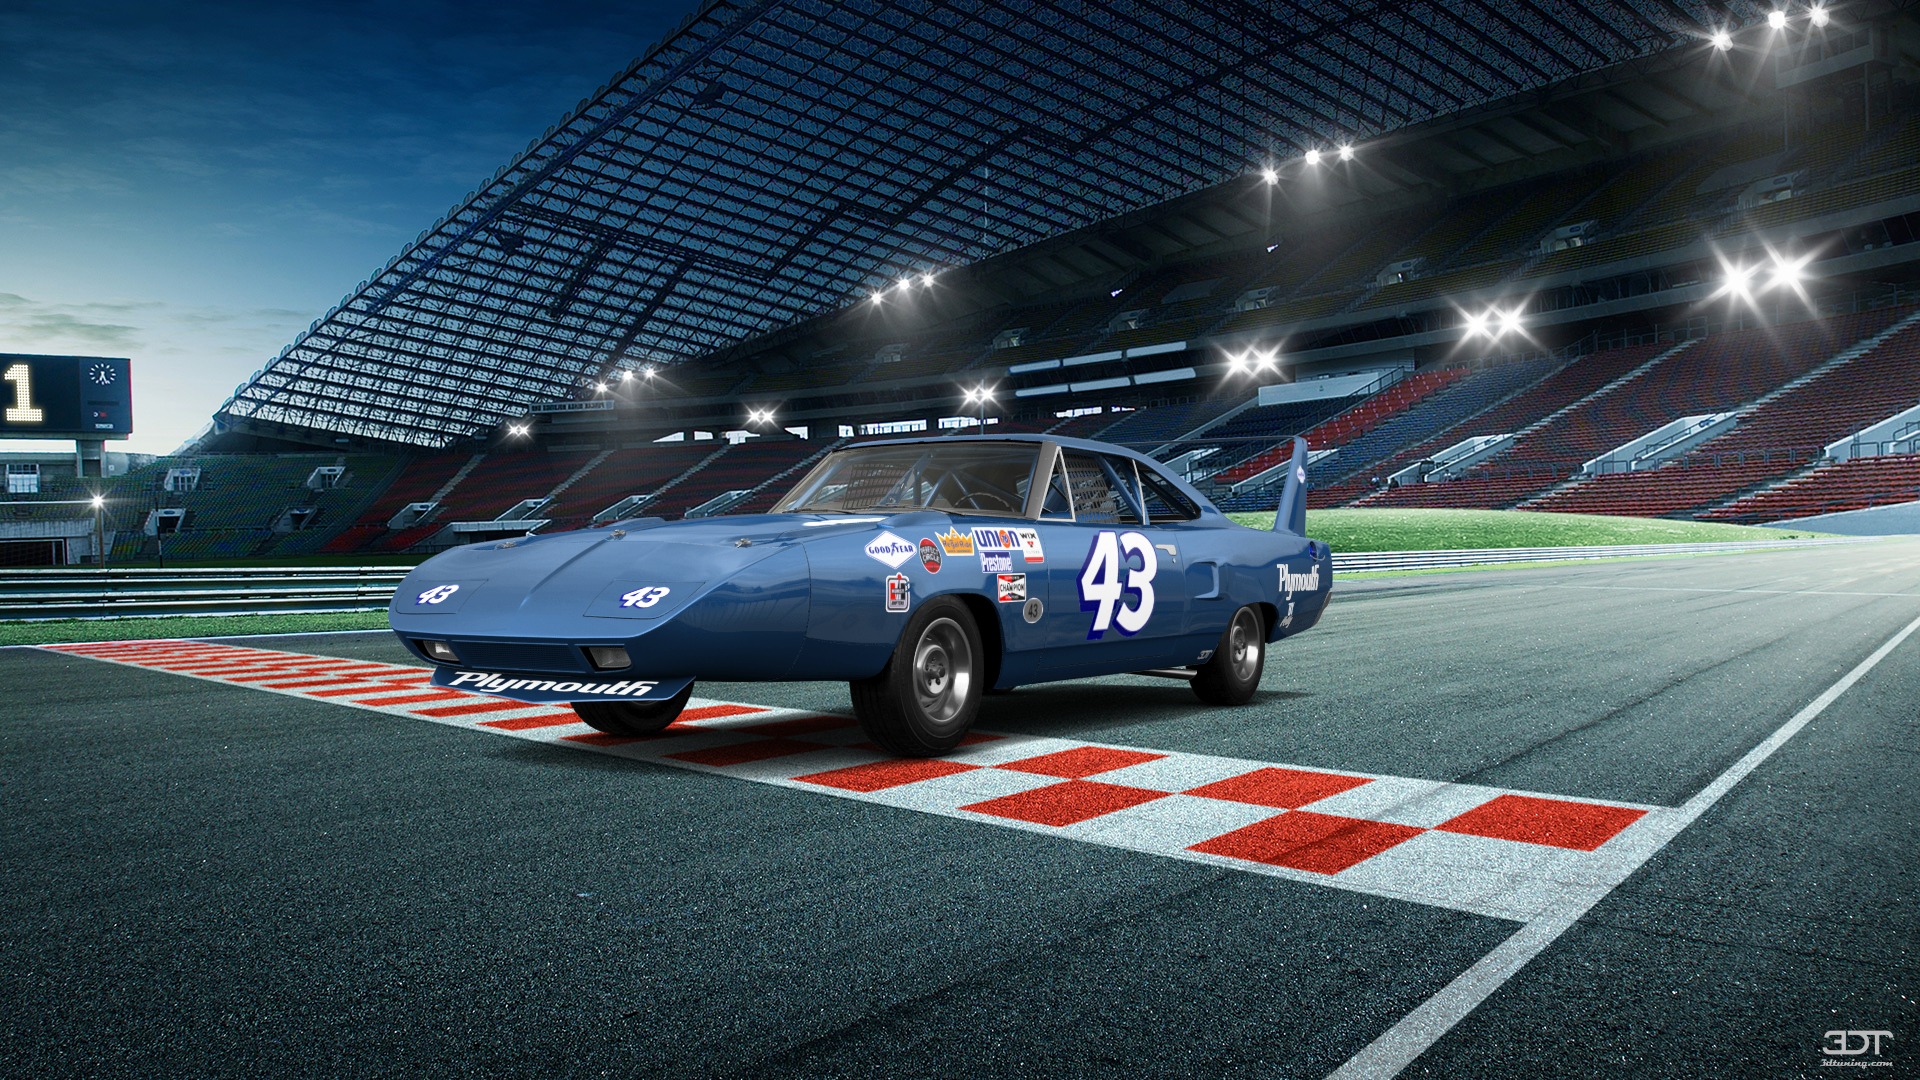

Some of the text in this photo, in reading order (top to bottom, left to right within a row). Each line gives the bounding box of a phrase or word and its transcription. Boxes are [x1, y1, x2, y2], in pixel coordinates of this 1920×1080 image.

[4, 363, 43, 422] 1
[980, 552, 1012, 571] Prestone
[1000, 582, 1025, 592] CHAMPION
[1077, 530, 1158, 639] 43
[1277, 563, 1320, 601] Plymouth
[415, 584, 460, 606] 43
[619, 586, 671, 609] 43
[1028, 603, 1038, 618] 43
[448, 670, 660, 697] Plymouth
